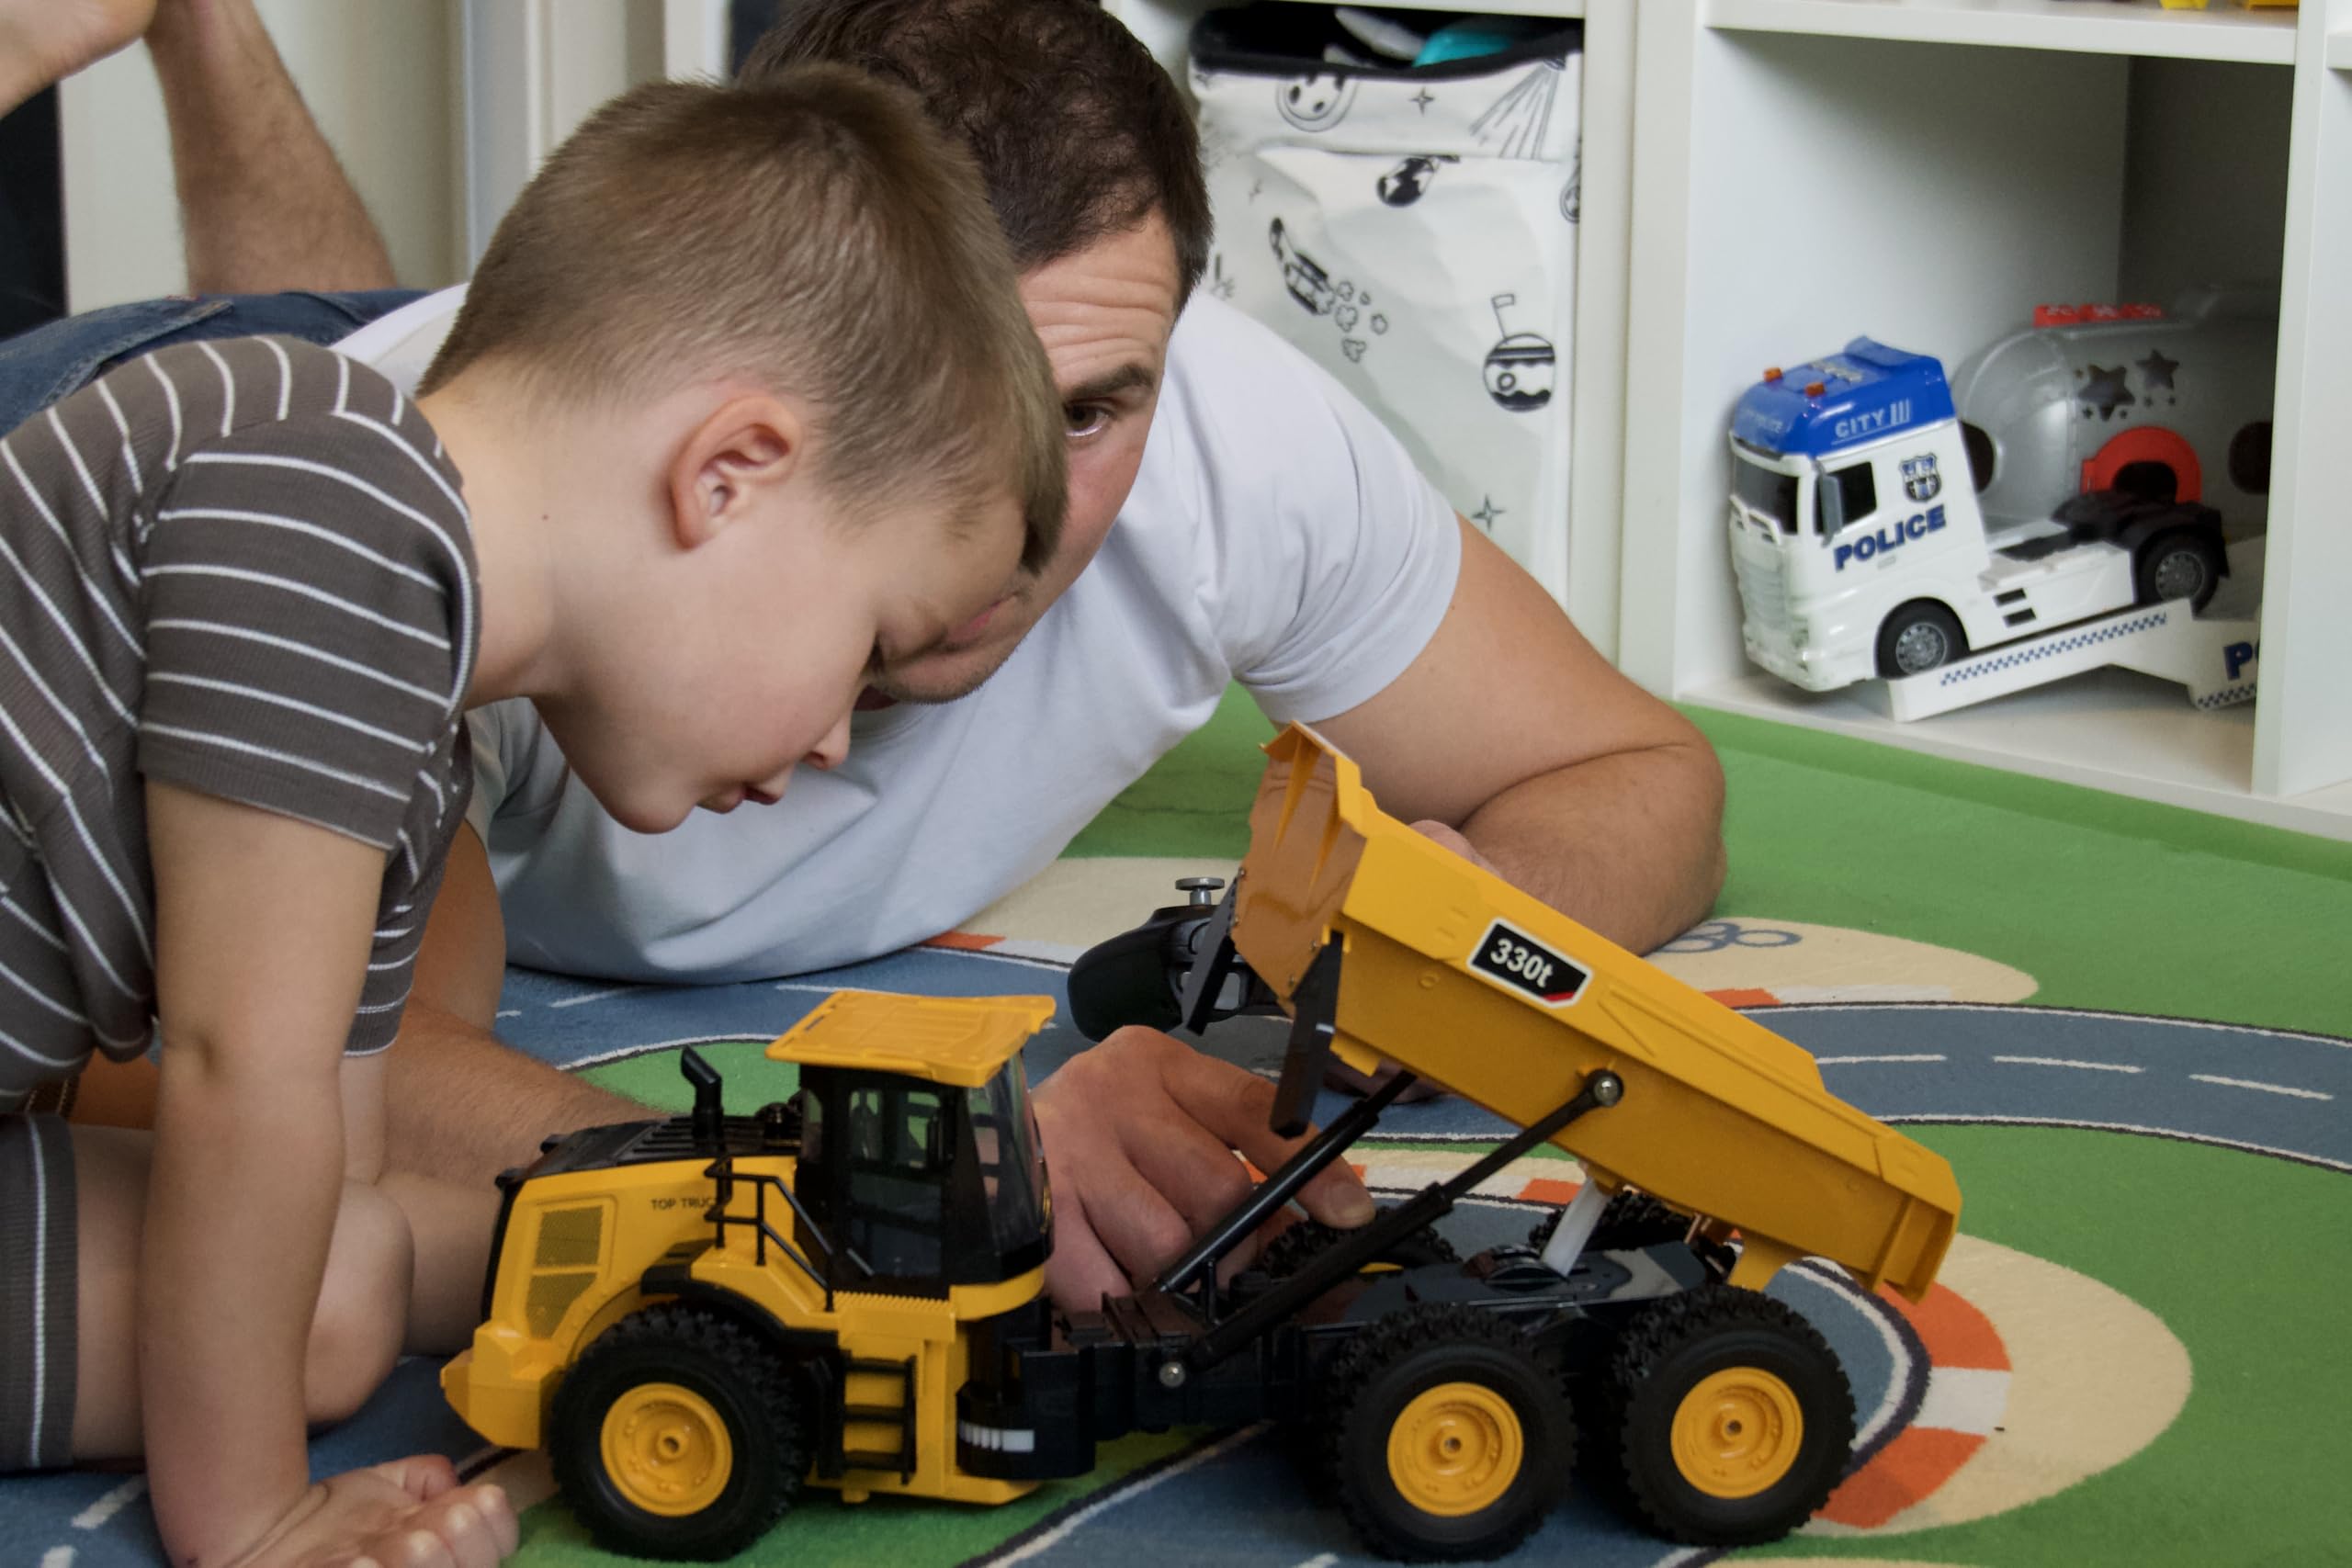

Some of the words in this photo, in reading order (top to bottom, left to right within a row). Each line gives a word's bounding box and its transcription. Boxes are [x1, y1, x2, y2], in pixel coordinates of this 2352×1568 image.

[1835, 408, 1884, 438] CITY
[1834, 504, 1946, 572] POLICE
[2223, 641, 2259, 680] P
[1490, 938, 1554, 988] 330t
[650, 1198, 676, 1210] TOP
[681, 1197, 717, 1208] TRUC
